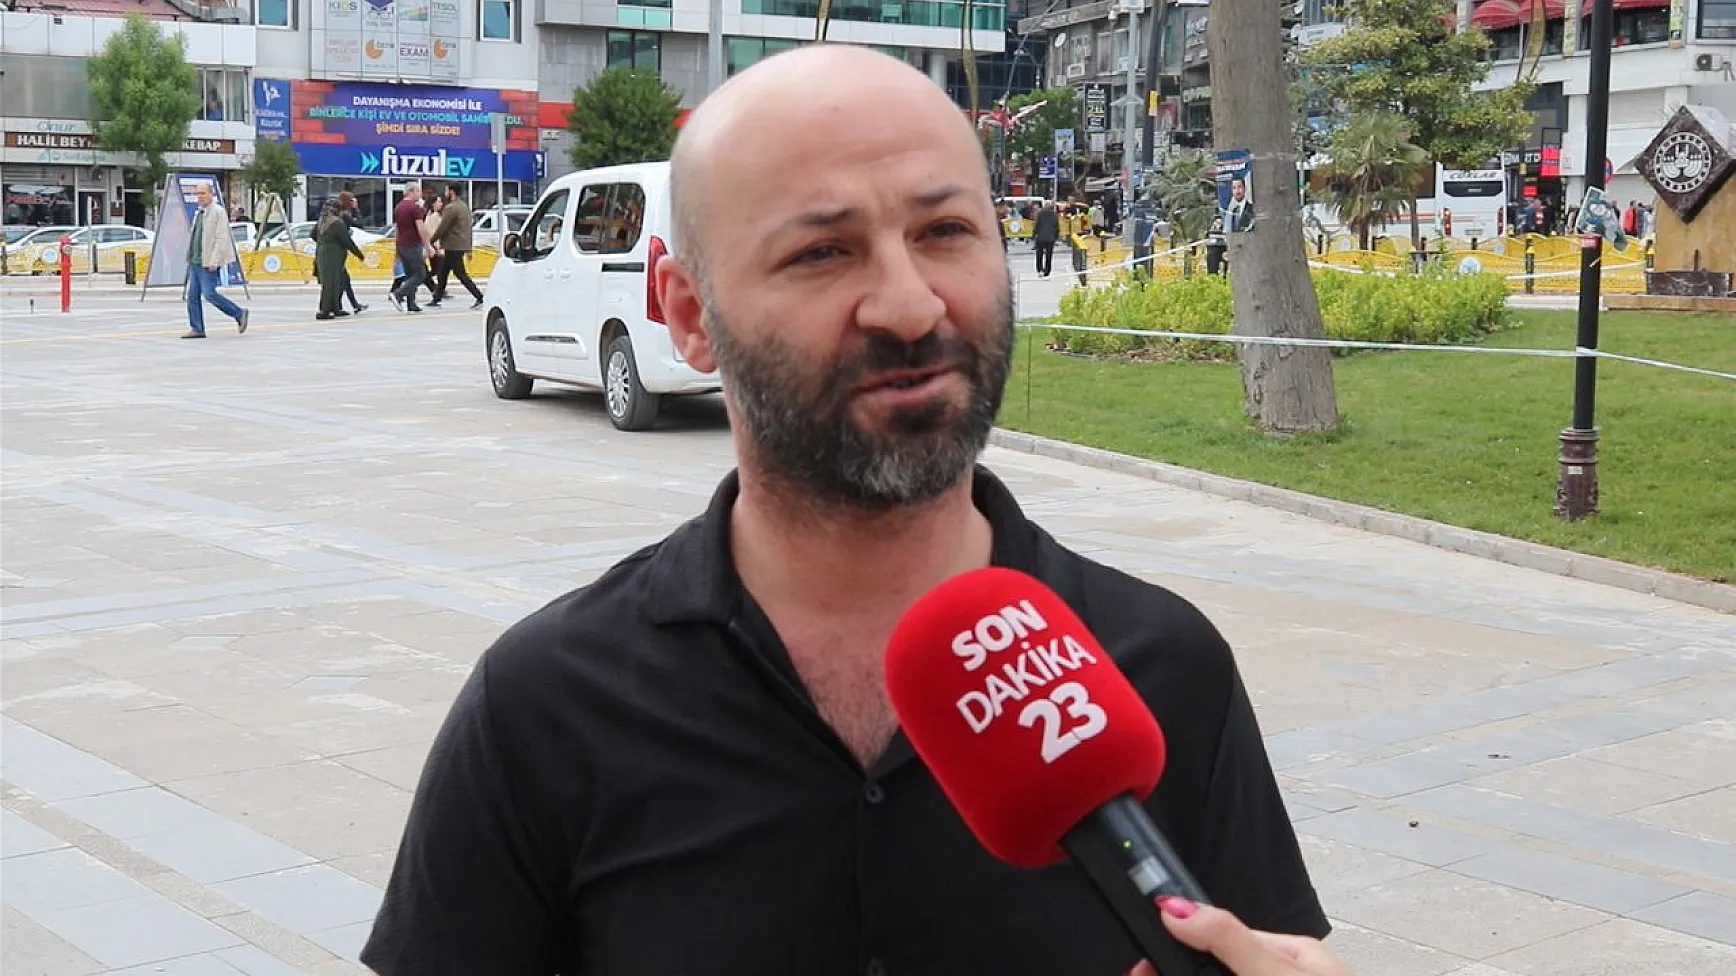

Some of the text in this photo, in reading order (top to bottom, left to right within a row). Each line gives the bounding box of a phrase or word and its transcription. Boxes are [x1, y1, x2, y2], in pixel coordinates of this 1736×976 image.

[400, 47, 428, 57] EXAM
[353, 96, 483, 111] DAYANIŞMA EKONOMİSİ İLE
[357, 107, 378, 121] KİŞİ
[379, 109, 393, 120] EV
[394, 110, 407, 120] VE
[407, 111, 458, 122] OTOMOBİL
[17, 133, 59, 147] HALİL
[182, 139, 222, 152] KEBAP
[952, 600, 1049, 671] SON
[956, 634, 1097, 734] DAKİKA
[1018, 682, 1108, 764] 23
